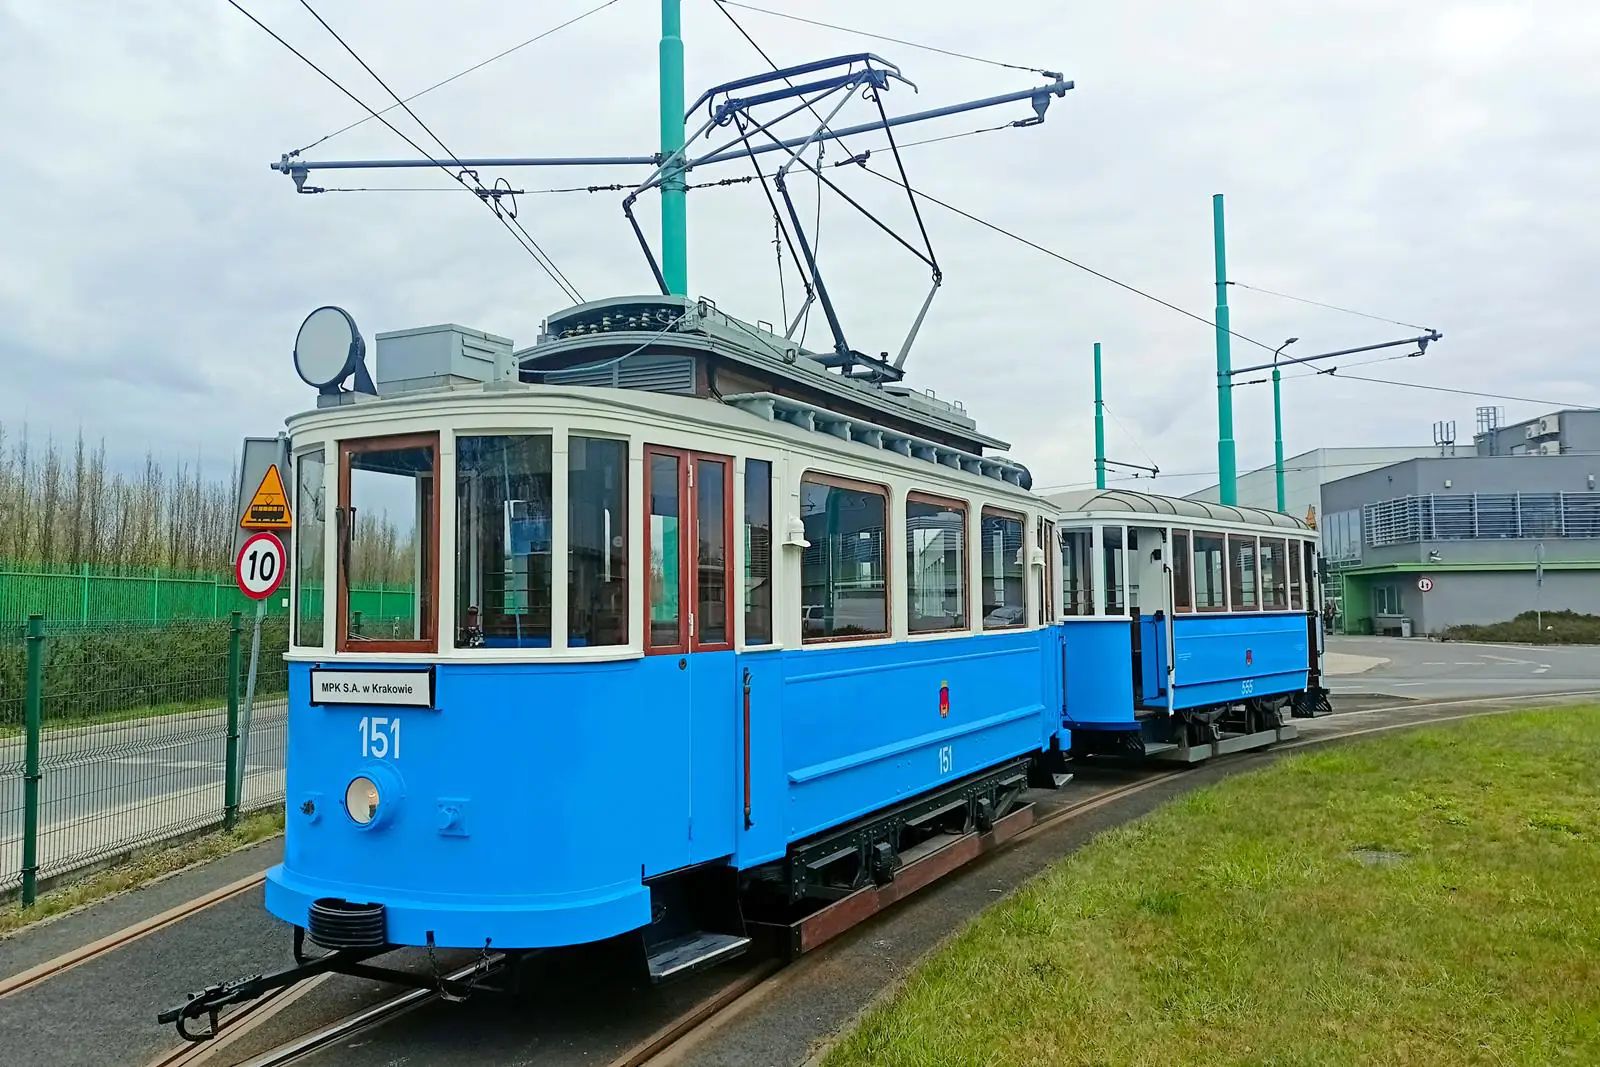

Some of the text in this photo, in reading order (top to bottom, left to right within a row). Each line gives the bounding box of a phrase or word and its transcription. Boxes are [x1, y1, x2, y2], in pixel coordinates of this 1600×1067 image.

[249, 550, 276, 581] 10
[322, 682, 413, 694] MPK S.A. w Krakowie
[1241, 680, 1254, 694] 555
[358, 716, 400, 759] 151
[939, 745, 952, 774] 151
